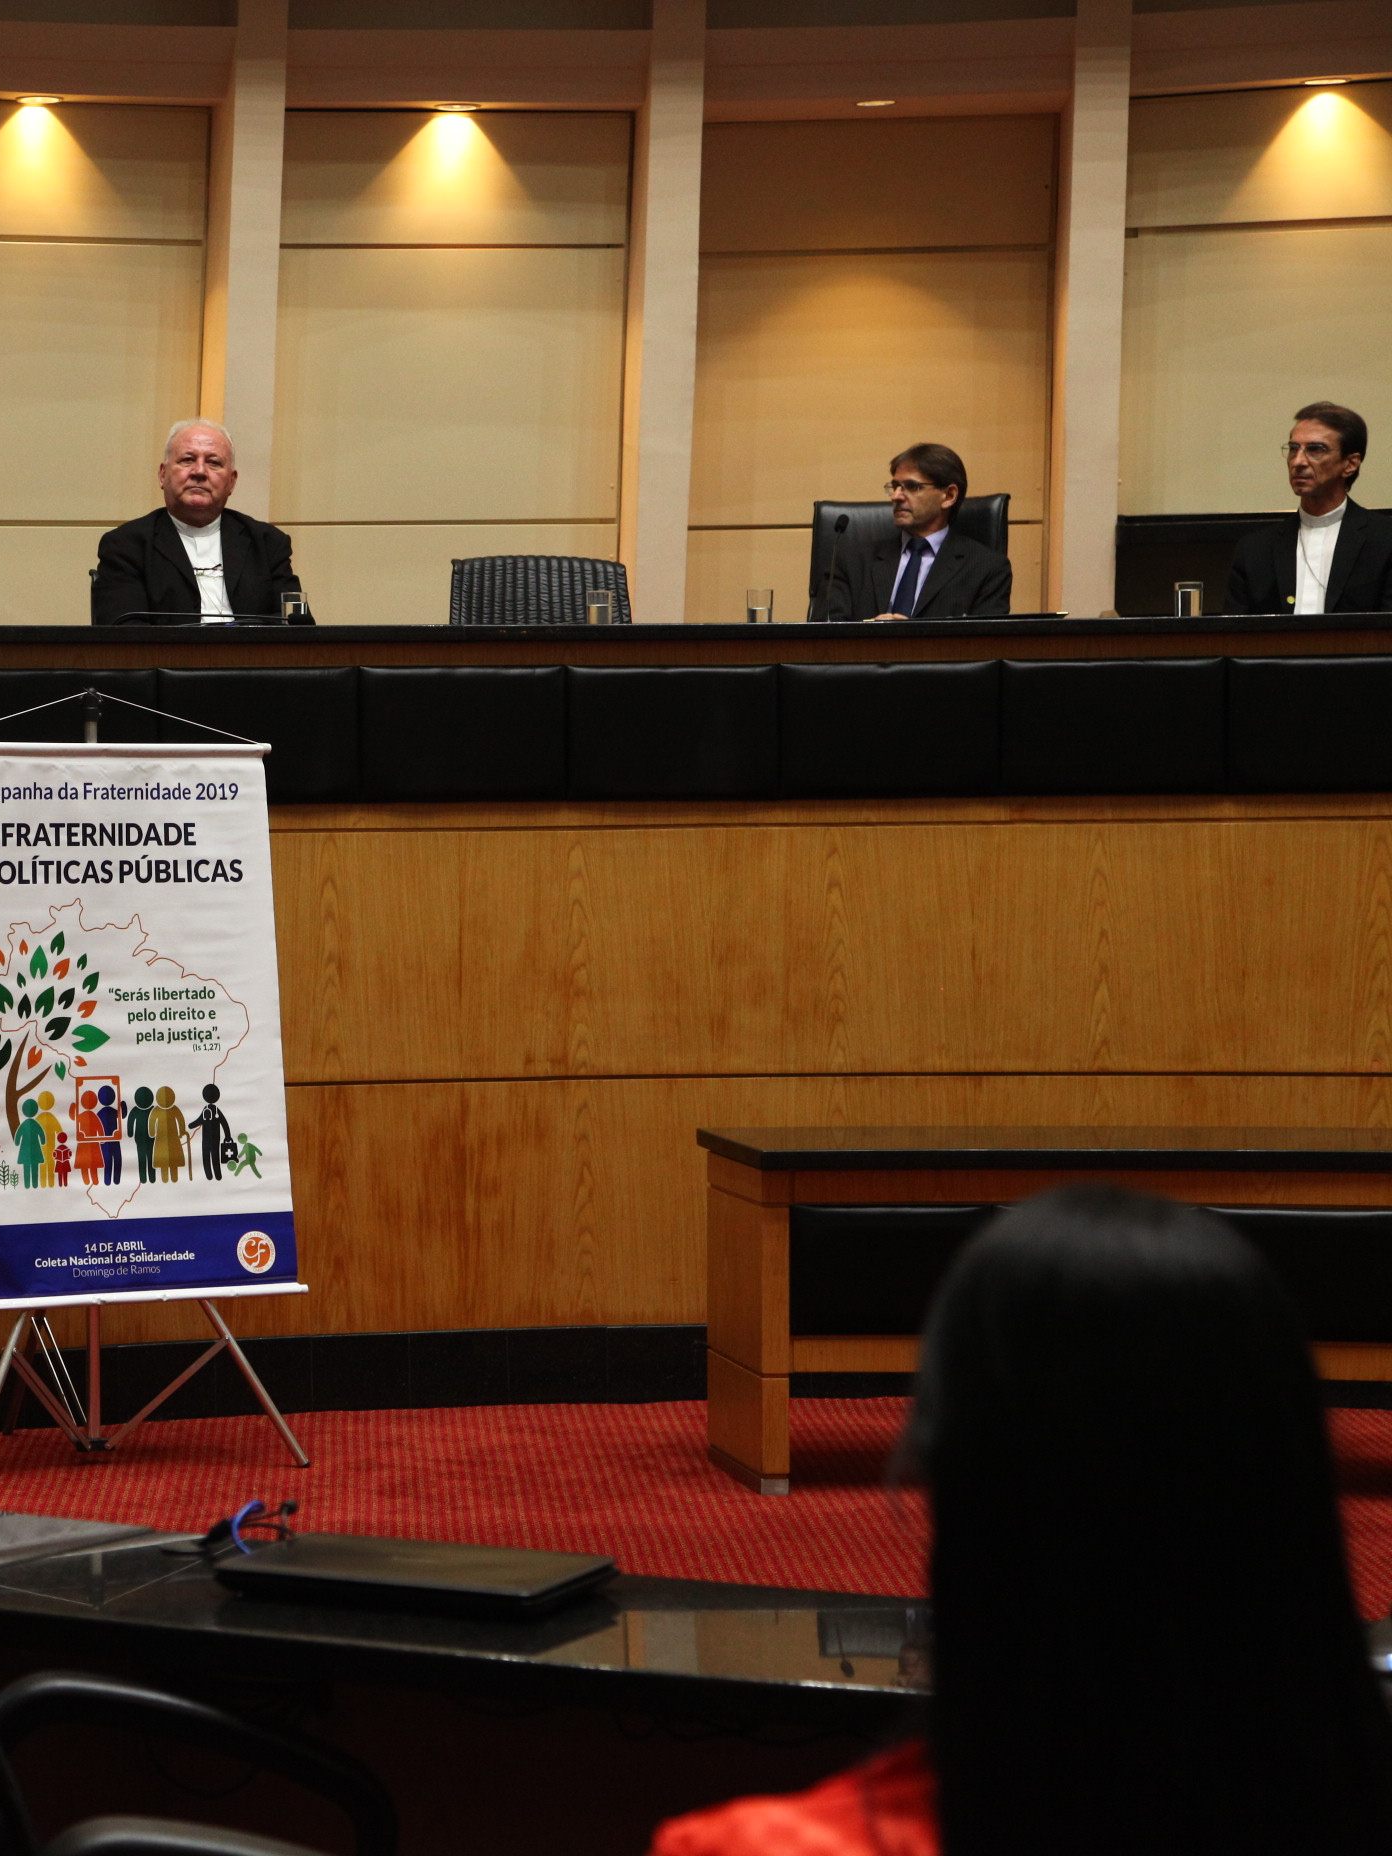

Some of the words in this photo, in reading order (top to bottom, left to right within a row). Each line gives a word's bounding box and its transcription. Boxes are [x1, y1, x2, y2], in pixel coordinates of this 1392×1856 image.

[58, 782, 79, 800] da
[83, 782, 192, 801] Fraternidade
[195, 782, 239, 801] 2019
[1, 822, 197, 847] FRATERNIDADE
[118, 854, 244, 884] PÚBLICAS
[153, 986, 216, 1001] libertado
[127, 1007, 157, 1025] pelo
[159, 1006, 206, 1021] direito
[208, 1009, 217, 1020] e
[136, 1028, 165, 1045] pela
[84, 1243, 98, 1254] 14
[99, 1242, 114, 1253] DE
[115, 1241, 147, 1252] ABRIL
[34, 1257, 68, 1268] Coleta
[69, 1254, 114, 1266] Nacional
[115, 1253, 128, 1264] da
[129, 1250, 196, 1263] Solidariedade
[72, 1266, 115, 1278] Domingo
[116, 1265, 129, 1276] de
[130, 1264, 161, 1275] Ramos
